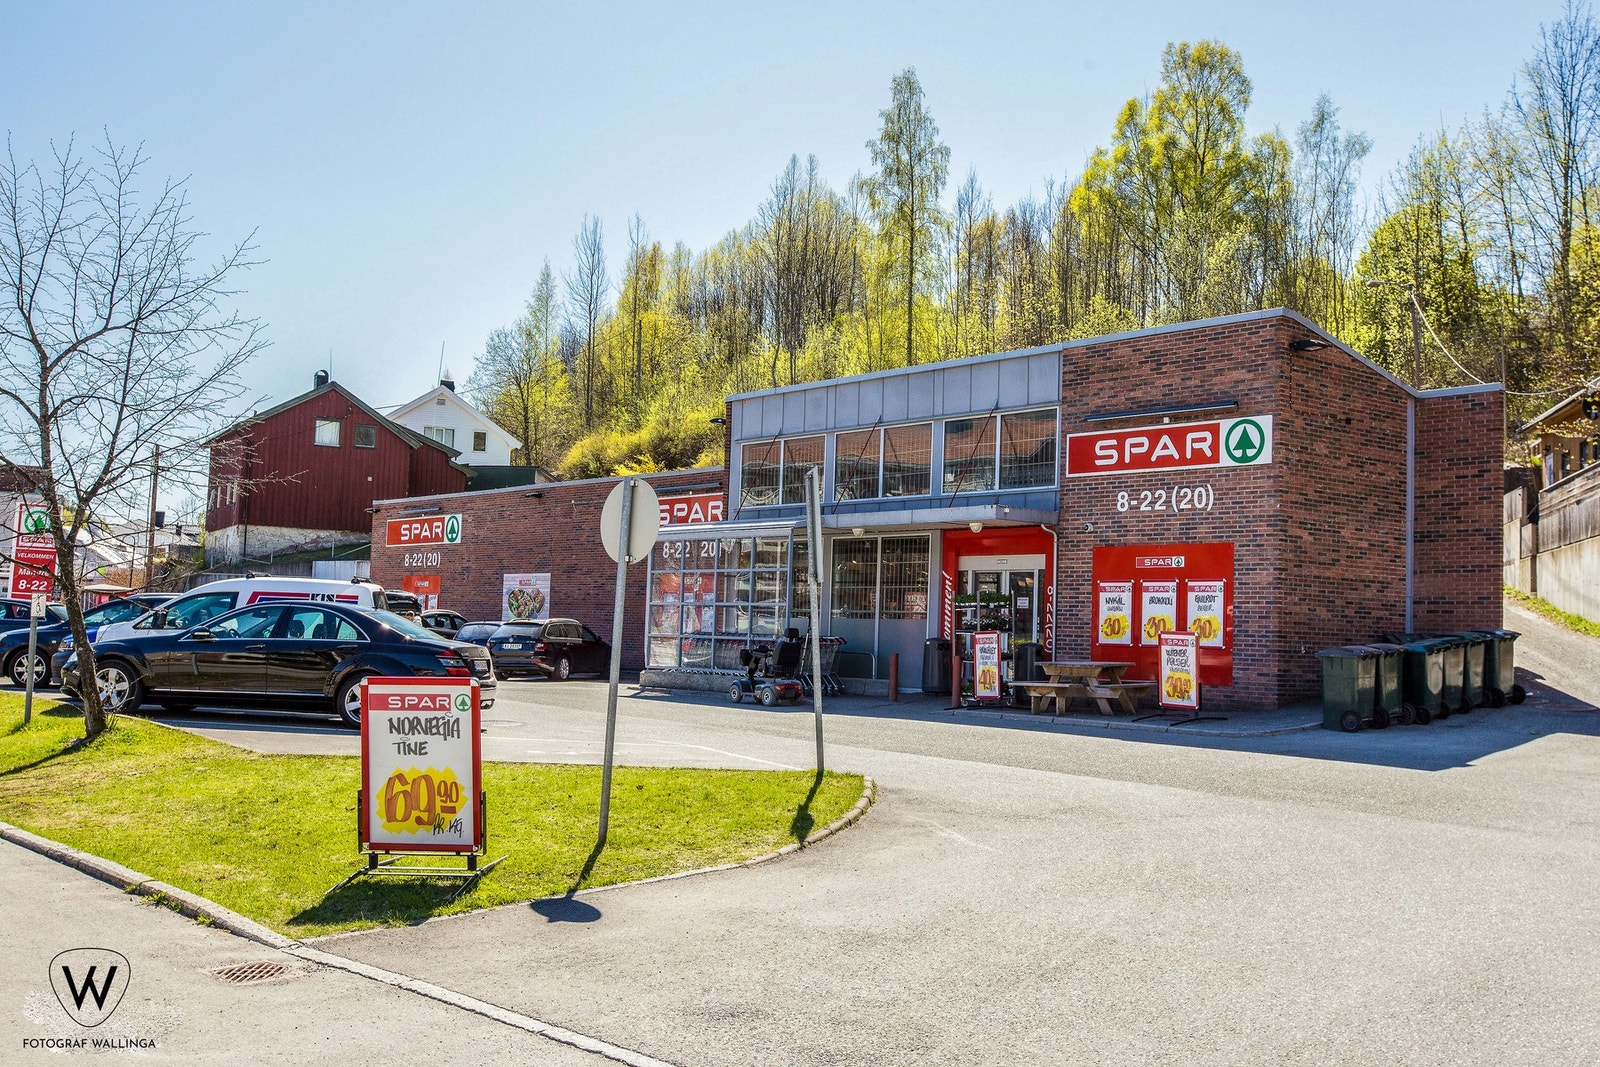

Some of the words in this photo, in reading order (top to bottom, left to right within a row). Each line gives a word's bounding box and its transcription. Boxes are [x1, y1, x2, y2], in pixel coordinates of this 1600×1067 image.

[1094, 431, 1213, 466] SPAR
[1116, 483, 1214, 513] 8-22(20)
[659, 500, 723, 526] SPAR
[400, 521, 443, 541] SPAR
[17, 552, 54, 560] VELKOMMEN
[404, 551, 441, 568] 8-22(20)
[1144, 558, 1172, 566] SPAR
[18, 579, 48, 591] 8-22
[942, 570, 953, 641] ommen!
[388, 696, 450, 709] SPAR
[387, 712, 461, 741] NORVEGIA
[392, 737, 429, 756] TINE
